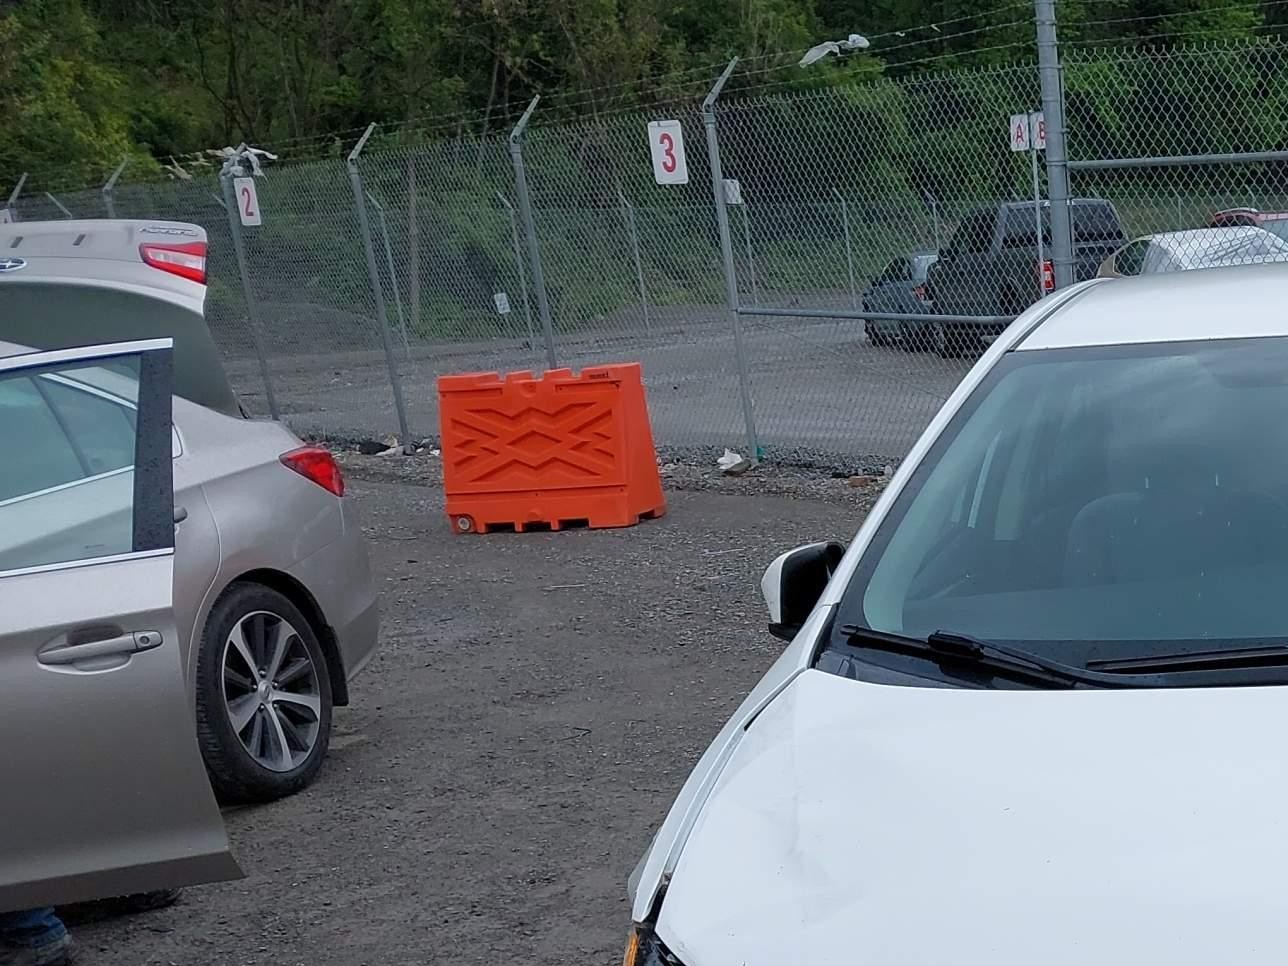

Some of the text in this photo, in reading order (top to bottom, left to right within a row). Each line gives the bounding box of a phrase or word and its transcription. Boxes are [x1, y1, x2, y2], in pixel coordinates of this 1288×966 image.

[1015, 121, 1025, 143] A
[659, 132, 677, 173] 3
[241, 187, 255, 217] 2
